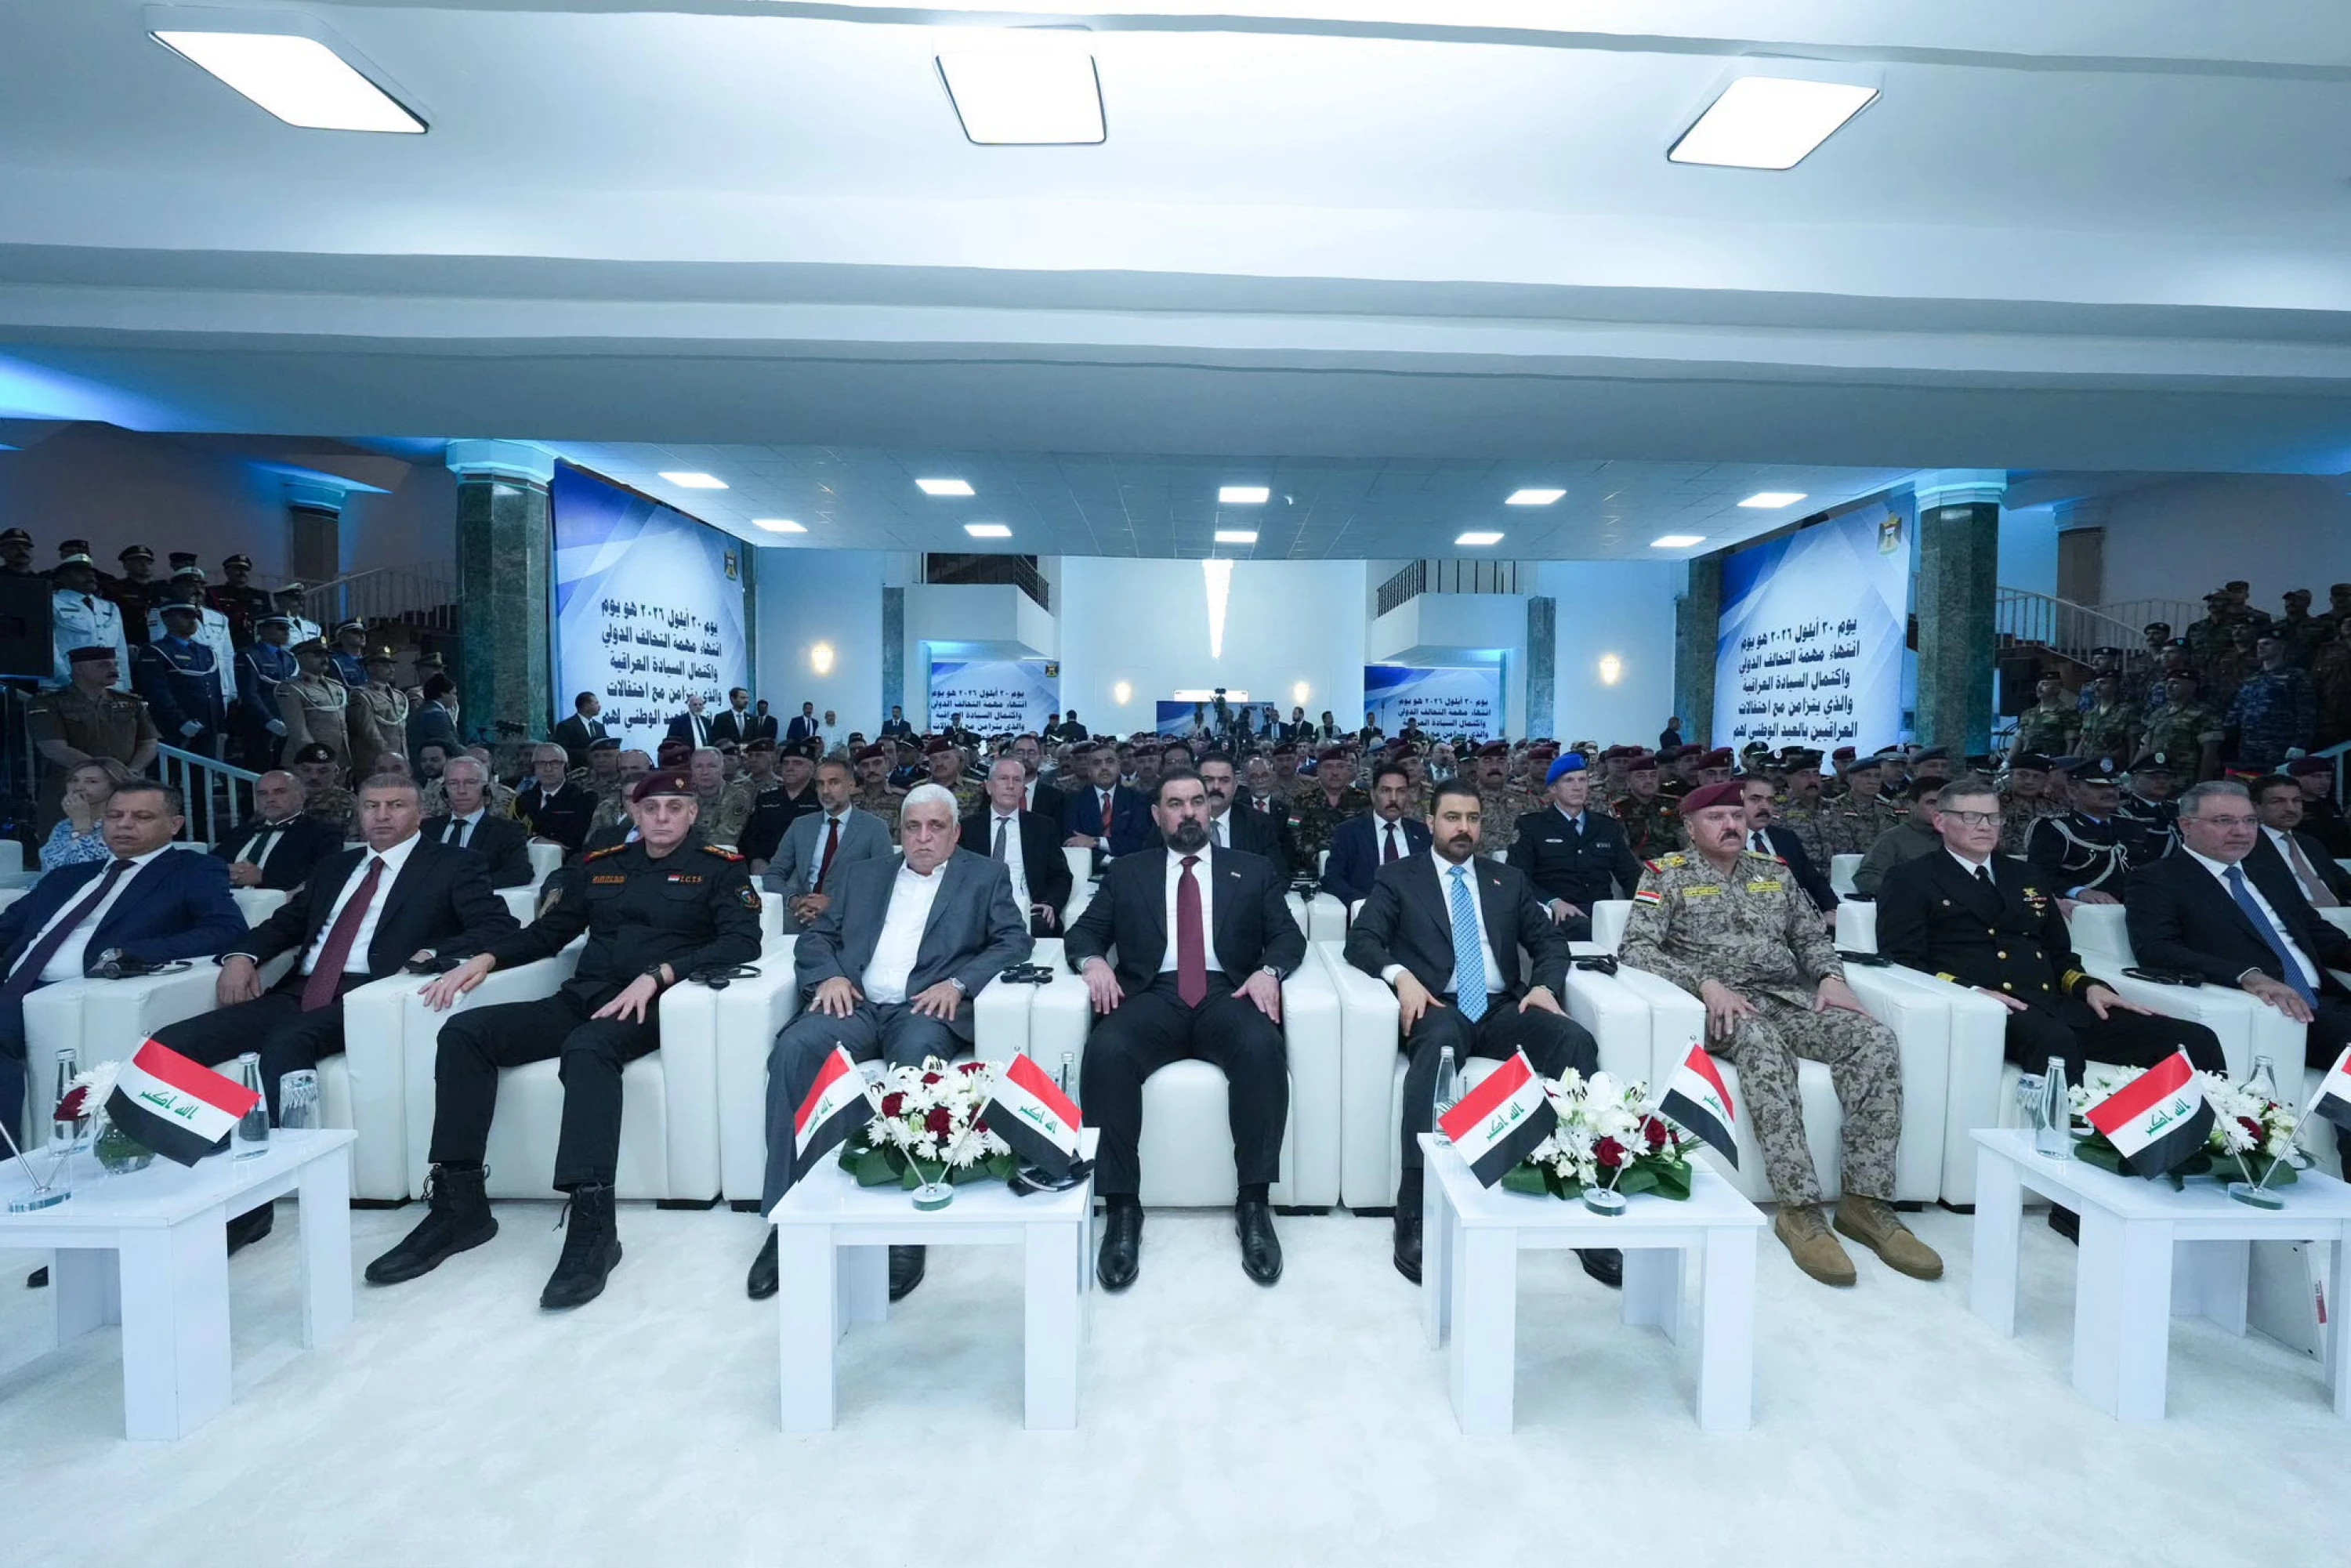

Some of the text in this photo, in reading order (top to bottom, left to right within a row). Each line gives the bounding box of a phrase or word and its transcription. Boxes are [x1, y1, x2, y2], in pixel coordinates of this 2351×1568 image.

[601, 599, 621, 617] يوم
[624, 601, 638, 620] هو
[640, 603, 665, 621] ٢٠٢٦
[668, 607, 690, 631] أيلول
[1837, 619, 1857, 638] يوم
[704, 621, 718, 637] يوم
[1770, 628, 1792, 643] ٢٠٢٦
[1795, 616, 1819, 643] أيلول
[602, 623, 722, 657] انتهاء مهمة التحالف الدولي
[1741, 636, 1755, 653] يوم
[1756, 632, 1768, 650] هو
[610, 650, 719, 683] واكتمال السيادة العراقية
[1738, 639, 1860, 678] انتهاء مهمة التحالف الدولي
[607, 679, 648, 699] احتفالات
[1742, 668, 1850, 696] واكتمال السيادة العراقية
[652, 686, 665, 704] مع
[1738, 694, 1853, 719] والذي يتزامن مع احتفالات
[602, 707, 621, 726] لهم
[625, 707, 661, 733] الوطني
[1733, 722, 1747, 741] لهم
[1780, 721, 1809, 741] بالعيد
[1810, 720, 1858, 743] العراقيين
[174, 1105, 200, 1120] الله
[1510, 1101, 1525, 1121] الله
[2175, 1098, 2191, 1117] الله
